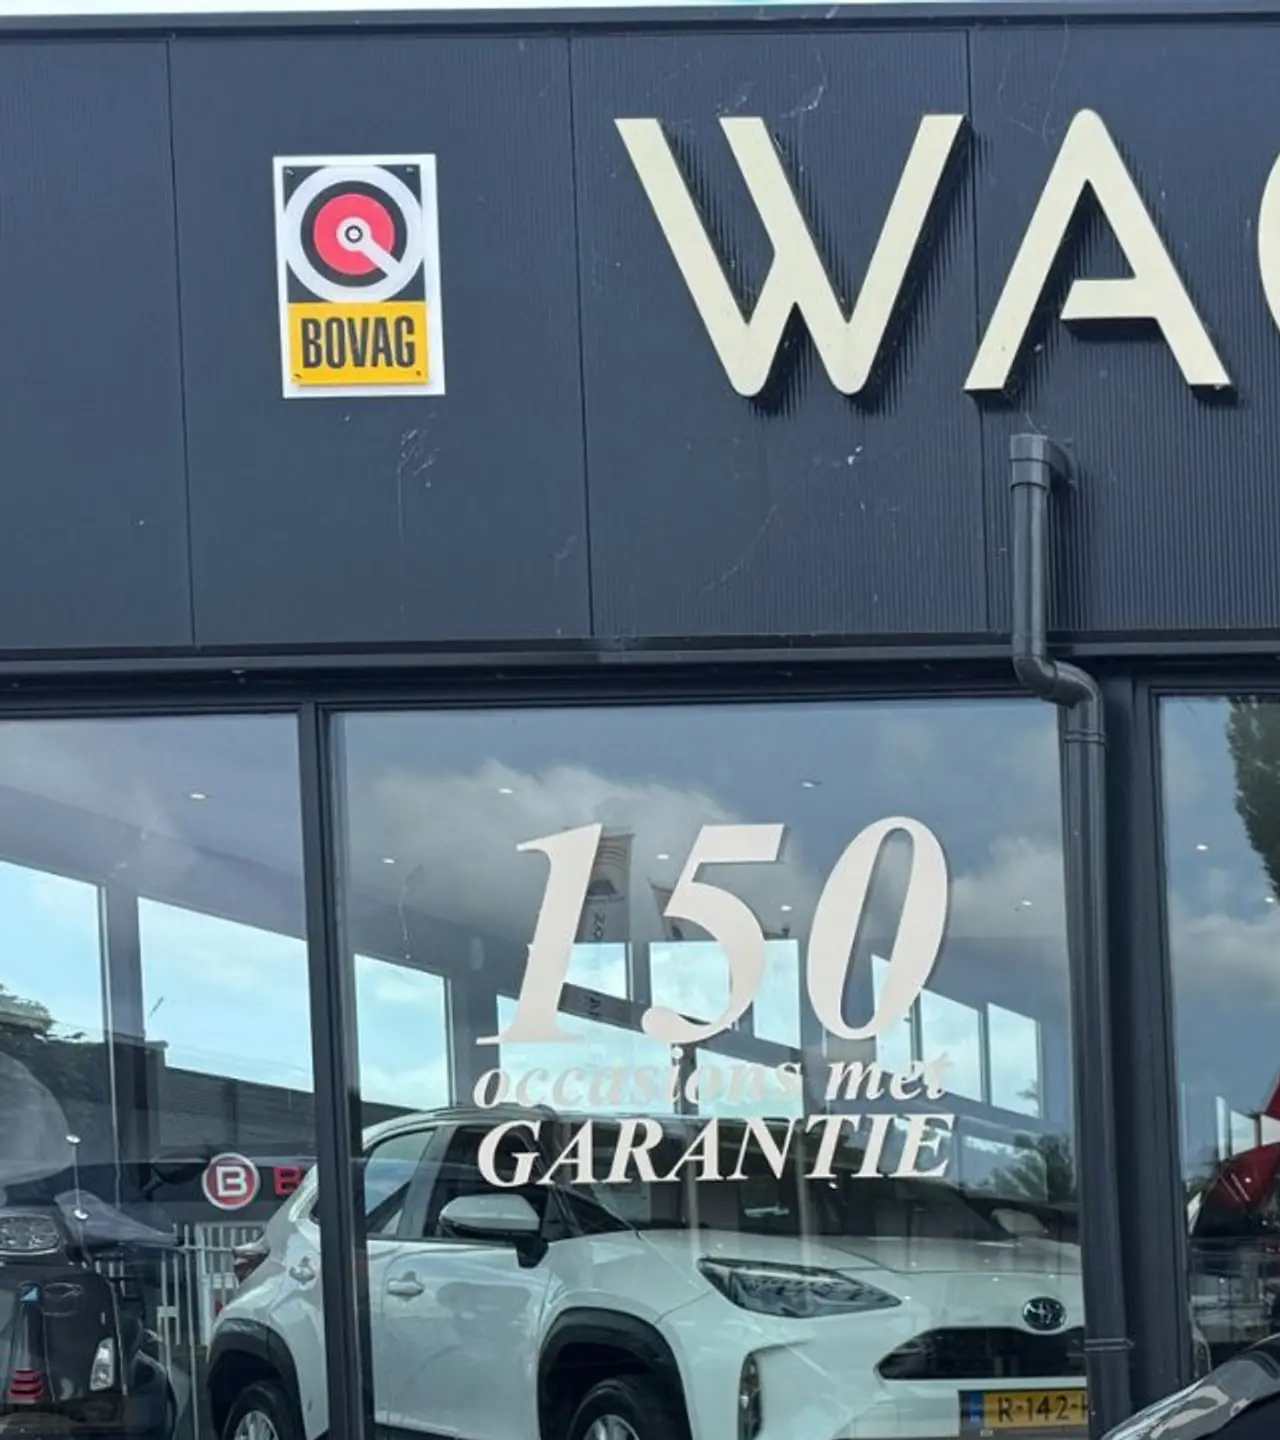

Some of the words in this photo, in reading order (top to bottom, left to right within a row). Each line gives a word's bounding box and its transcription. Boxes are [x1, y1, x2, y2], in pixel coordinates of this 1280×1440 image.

[300, 315, 416, 369] BOVAG
[476, 815, 948, 1045] 150
[473, 1047, 803, 1108] occasions
[824, 1052, 954, 1101] met
[477, 1113, 955, 1187] GARANTIE
